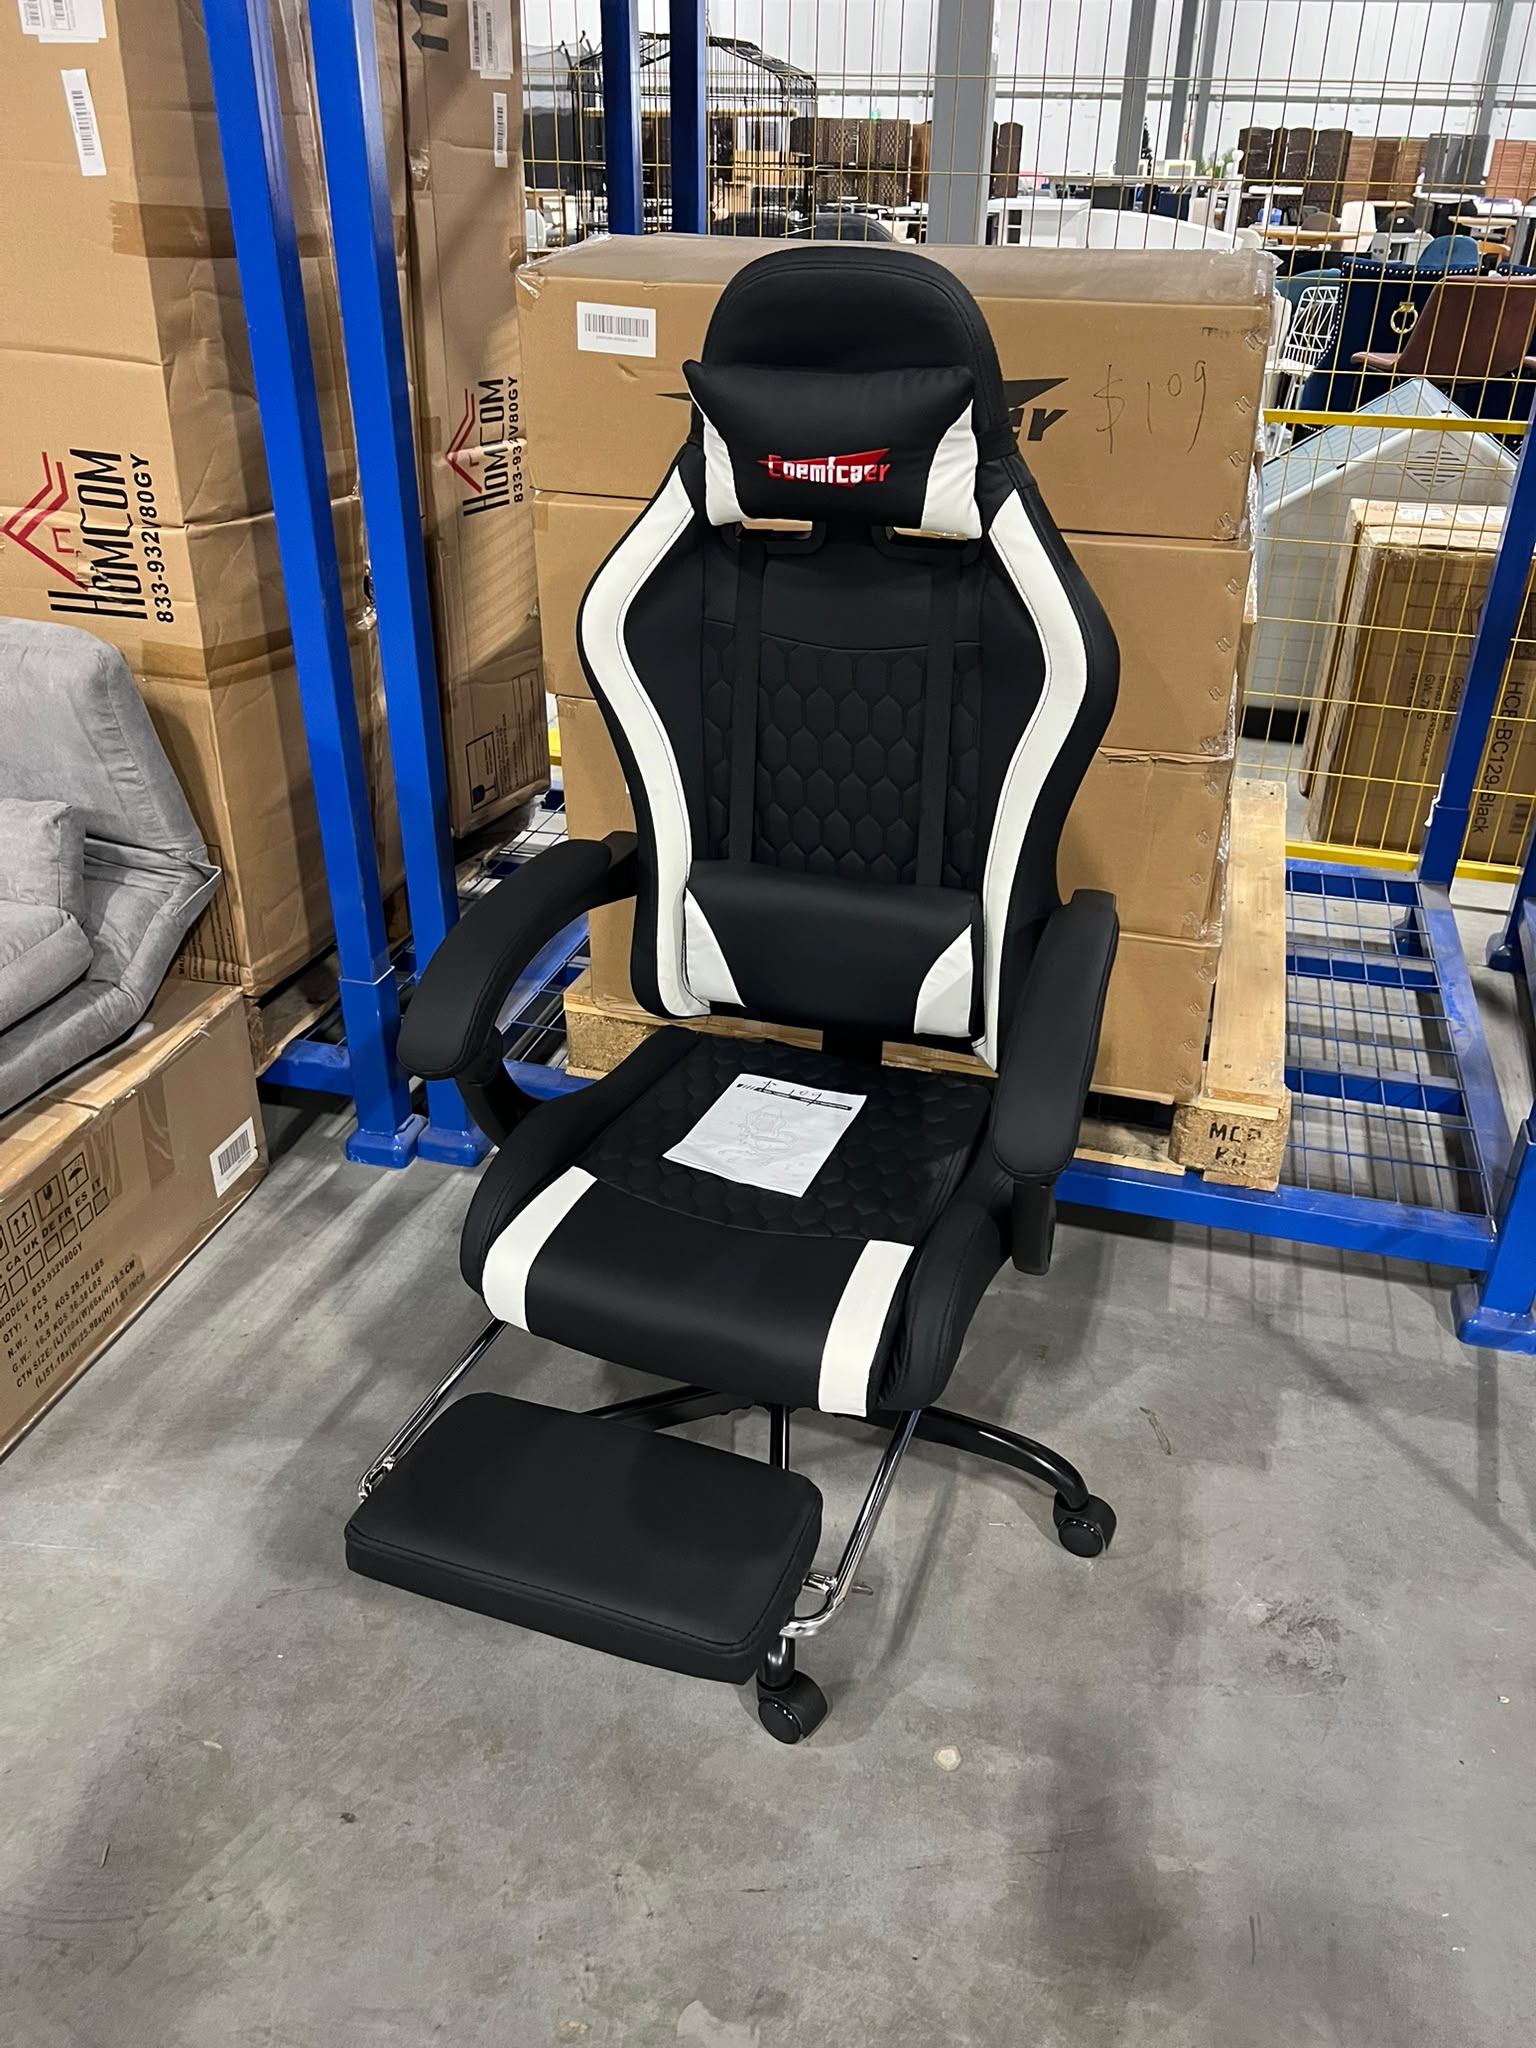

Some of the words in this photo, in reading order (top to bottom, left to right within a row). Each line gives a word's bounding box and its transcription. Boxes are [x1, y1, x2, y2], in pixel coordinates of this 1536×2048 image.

[507, 376, 524, 503] 833-932V80GY
[1093, 360, 1206, 454] $109
[130, 453, 174, 623] 833-932V80GY
[6, 1255, 21, 1273] CA
[23, 1236, 39, 1256] UK
[42, 1220, 56, 1239] DE
[57, 1206, 72, 1224] FR
[75, 1191, 88, 1207] ES
[91, 1176, 101, 1192] IT
[32, 1295, 48, 1316] PCS
[16, 1369, 33, 1388] CTN
